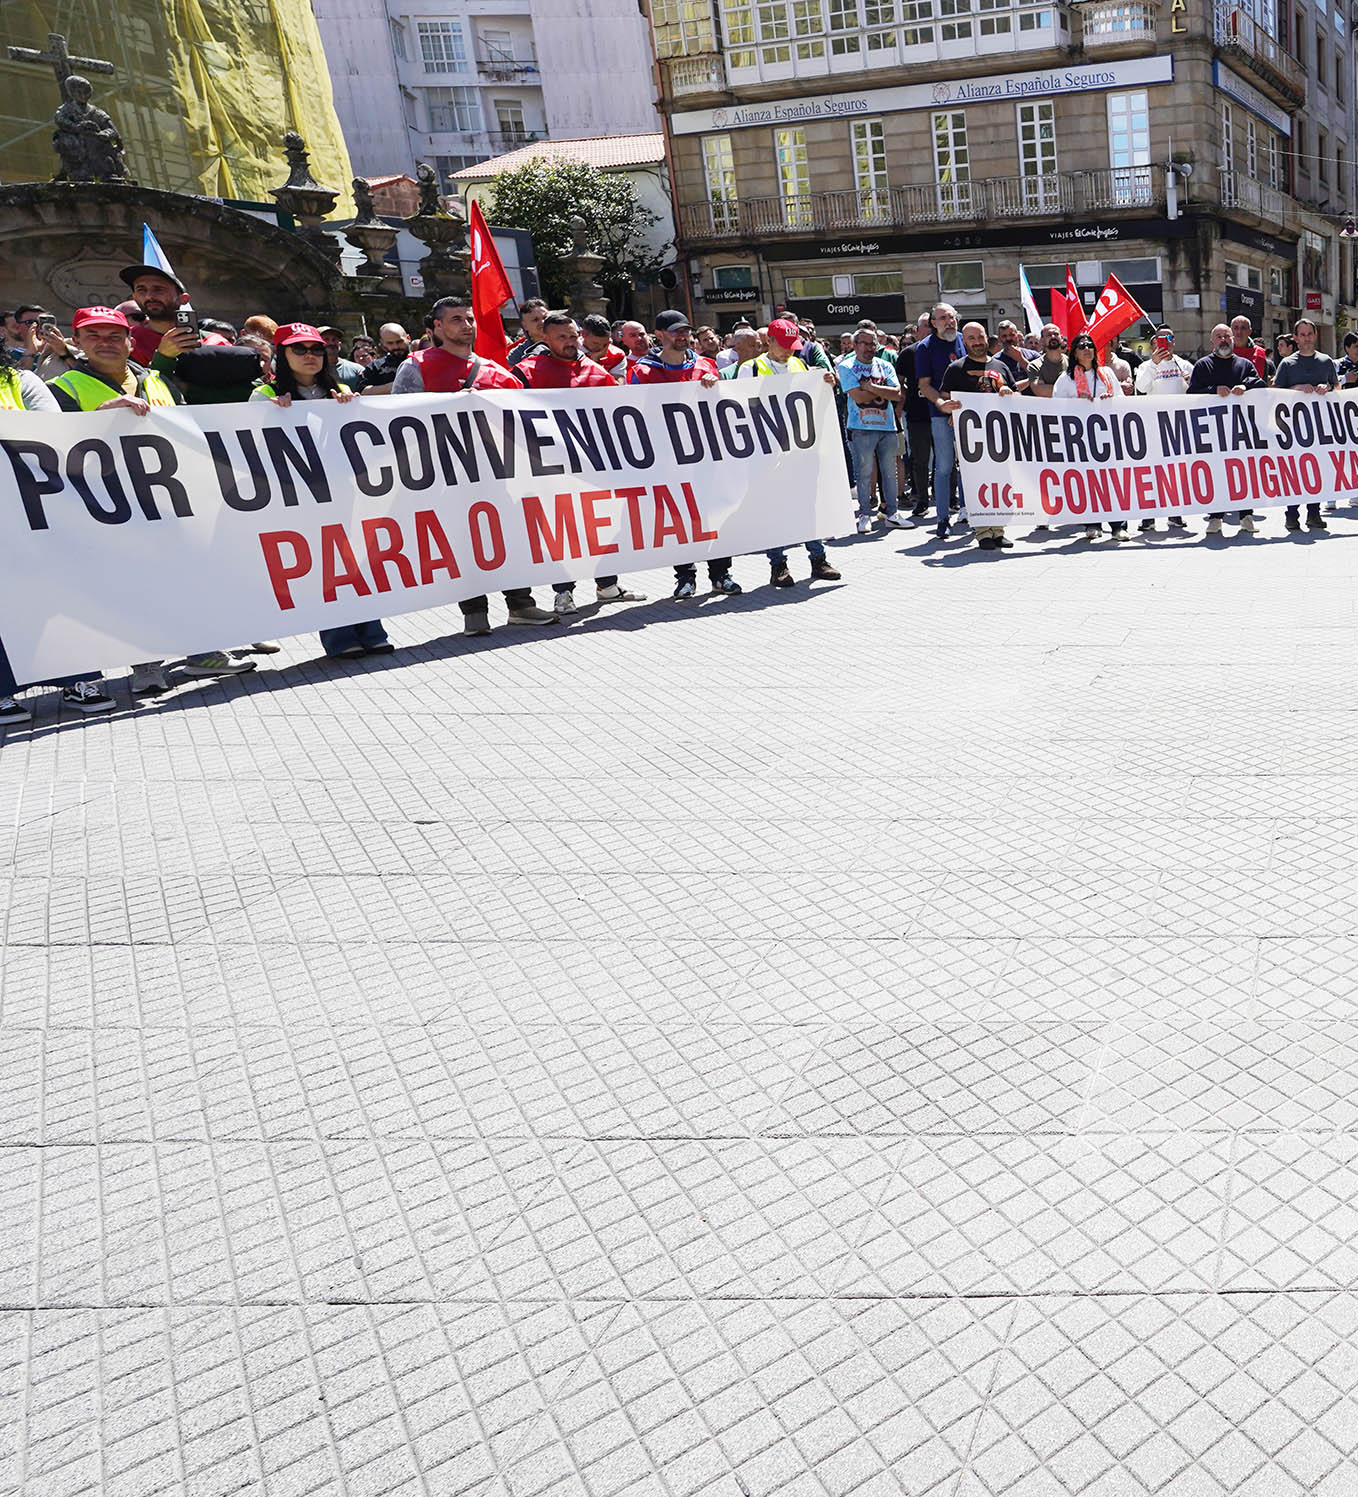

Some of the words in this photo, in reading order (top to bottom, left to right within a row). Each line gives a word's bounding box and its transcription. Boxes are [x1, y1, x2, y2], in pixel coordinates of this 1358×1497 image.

[957, 83, 1002, 99] Alianza
[1005, 74, 1062, 95] Española
[1064, 71, 1116, 88] Seguros
[733, 110, 772, 124] Alianza
[774, 102, 822, 120] Española
[824, 99, 868, 115] Seguros
[827, 303, 860, 315] Orange
[958, 409, 1147, 463] COMERCIO
[1157, 404, 1268, 457] METAL
[0, 434, 195, 531] POR
[203, 425, 333, 512] UN
[339, 405, 655, 497] CONVENIO
[662, 391, 816, 466] DIGNO
[978, 482, 1024, 509] CIG
[1040, 460, 1215, 516] CONVENIO
[1224, 452, 1322, 502] DIGNO
[258, 508, 462, 611] PARA
[467, 500, 506, 571] O
[521, 481, 718, 564] METAL
